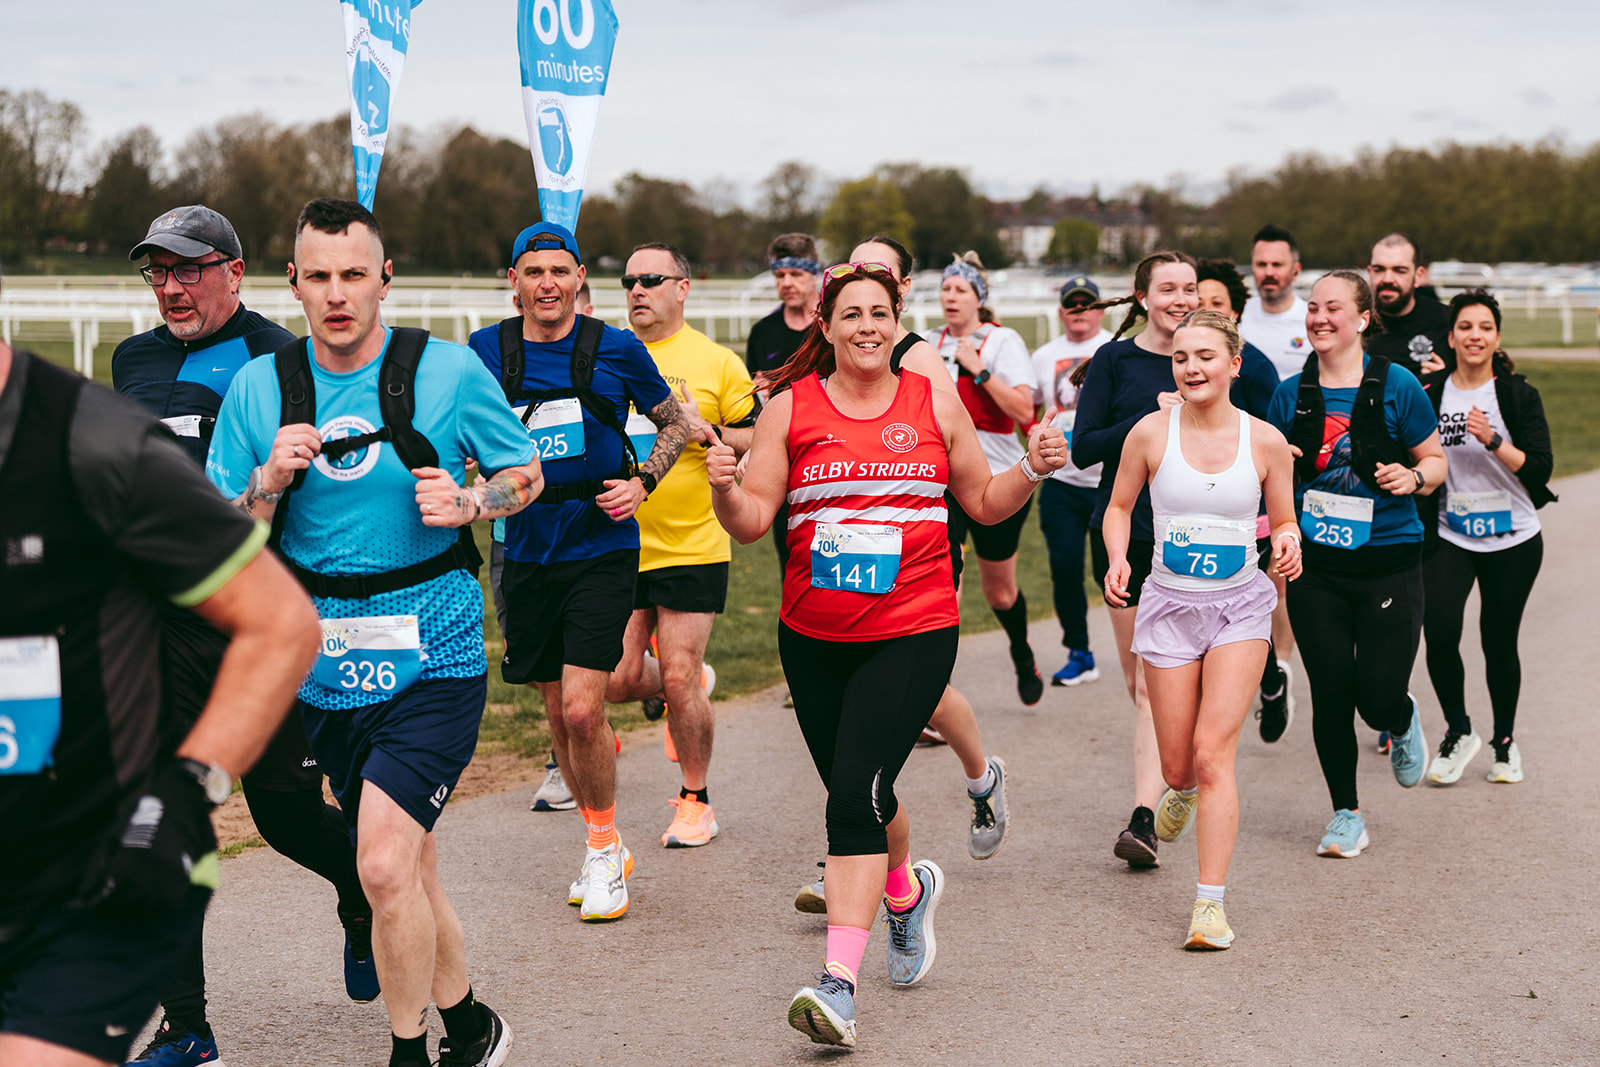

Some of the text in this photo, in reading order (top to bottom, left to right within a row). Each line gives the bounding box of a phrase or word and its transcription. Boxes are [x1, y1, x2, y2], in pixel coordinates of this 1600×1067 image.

[537, 53, 604, 83] minutes
[1438, 423, 1467, 436] UNN
[802, 460, 937, 483] SELBY STRIDERS
[1308, 503, 1326, 515] 10k
[1168, 531, 1190, 543] 10k
[1313, 521, 1353, 547] 253
[1462, 517, 1496, 537] 161
[817, 540, 840, 553] 10k
[1187, 552, 1218, 576] 75
[830, 562, 877, 590] 141
[338, 660, 397, 691] 326
